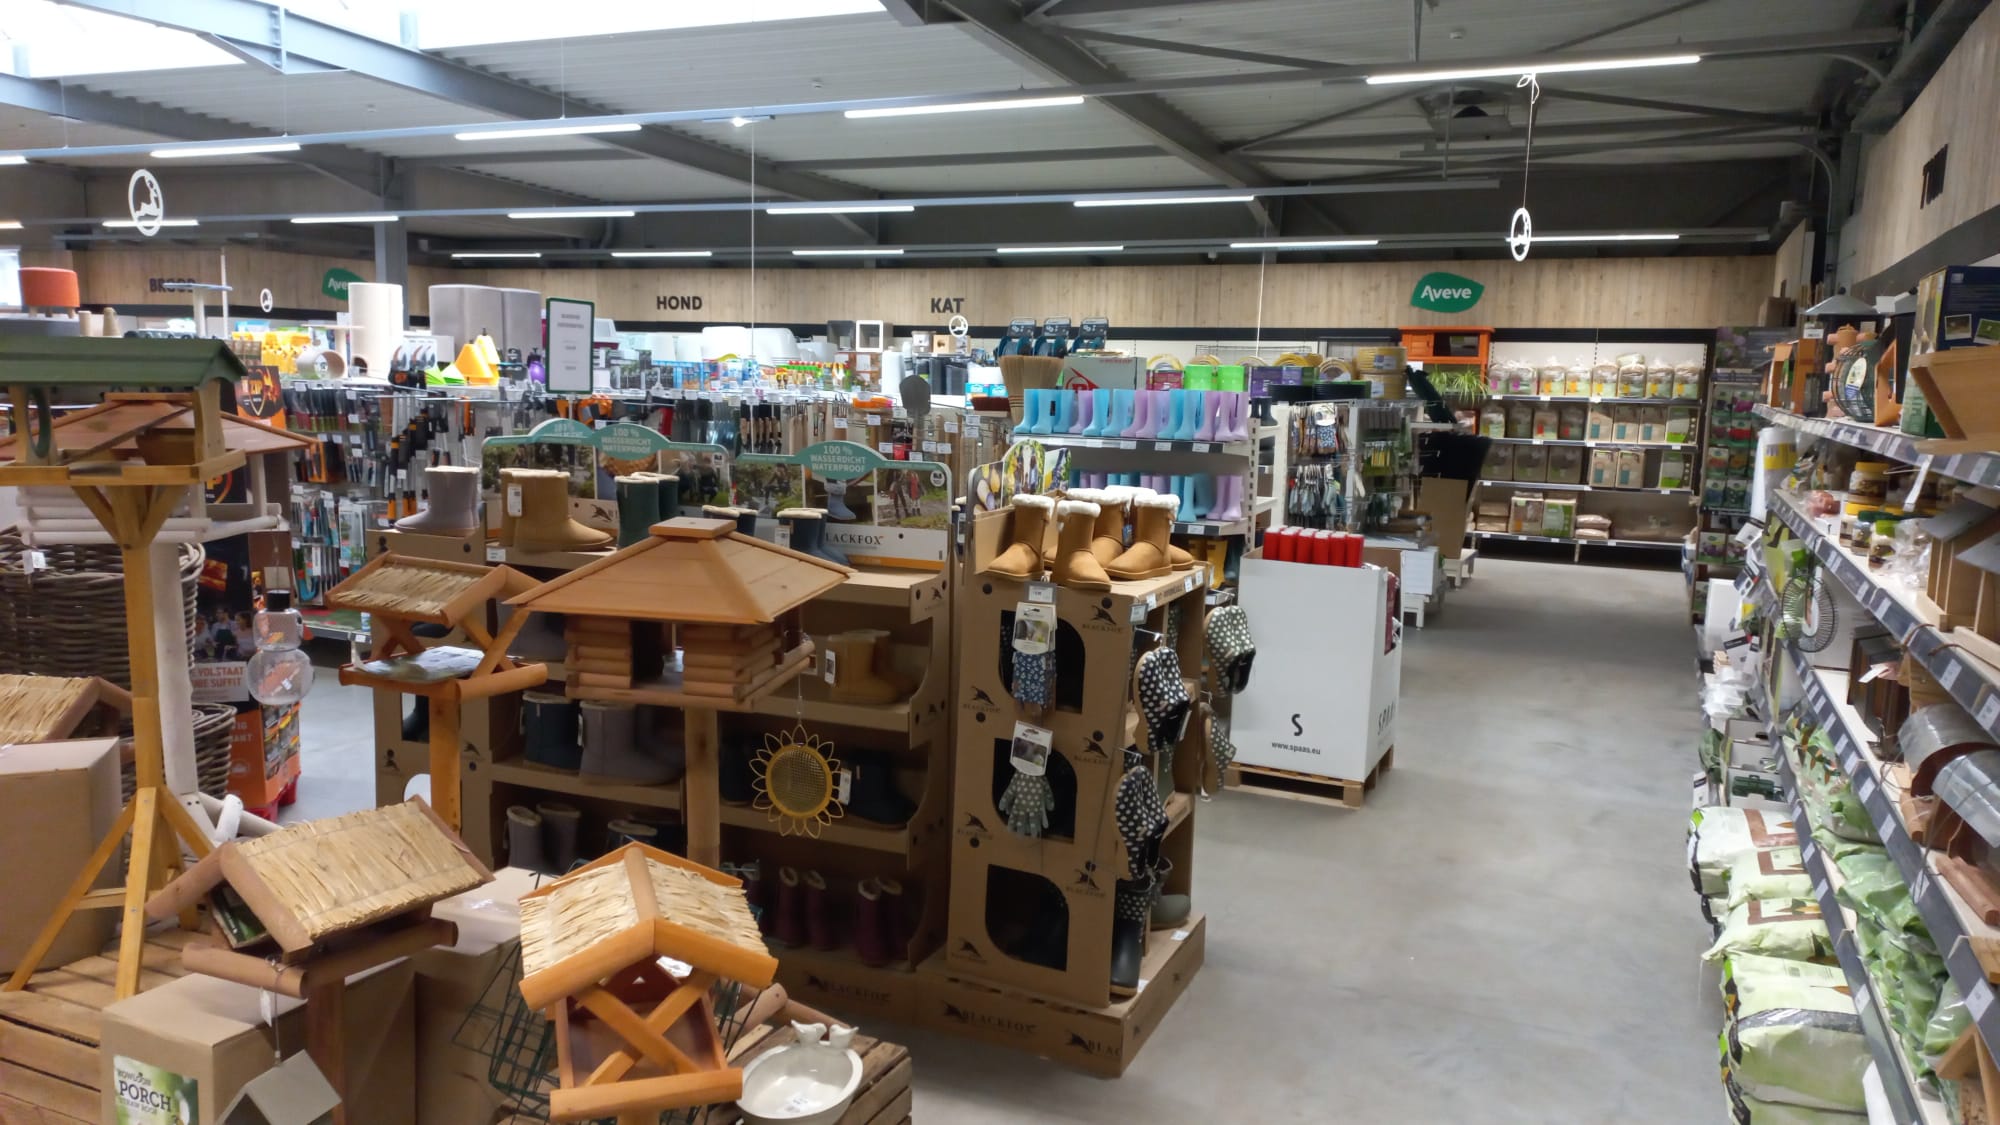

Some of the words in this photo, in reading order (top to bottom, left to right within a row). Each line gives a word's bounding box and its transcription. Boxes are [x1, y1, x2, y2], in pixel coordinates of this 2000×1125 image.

[1420, 284, 1472, 302] Aveve
[656, 295, 703, 311] HOND
[930, 297, 965, 314] KAT
[823, 445, 841, 455] 100
[809, 454, 867, 465] WASSERDICHT
[811, 463, 865, 473] WATERPROOF
[824, 531, 883, 546] LACKFOX
[1291, 713, 1304, 737] S
[1271, 741, 1321, 755] www.spaas.eu
[119, 1080, 172, 1112] PORCH
